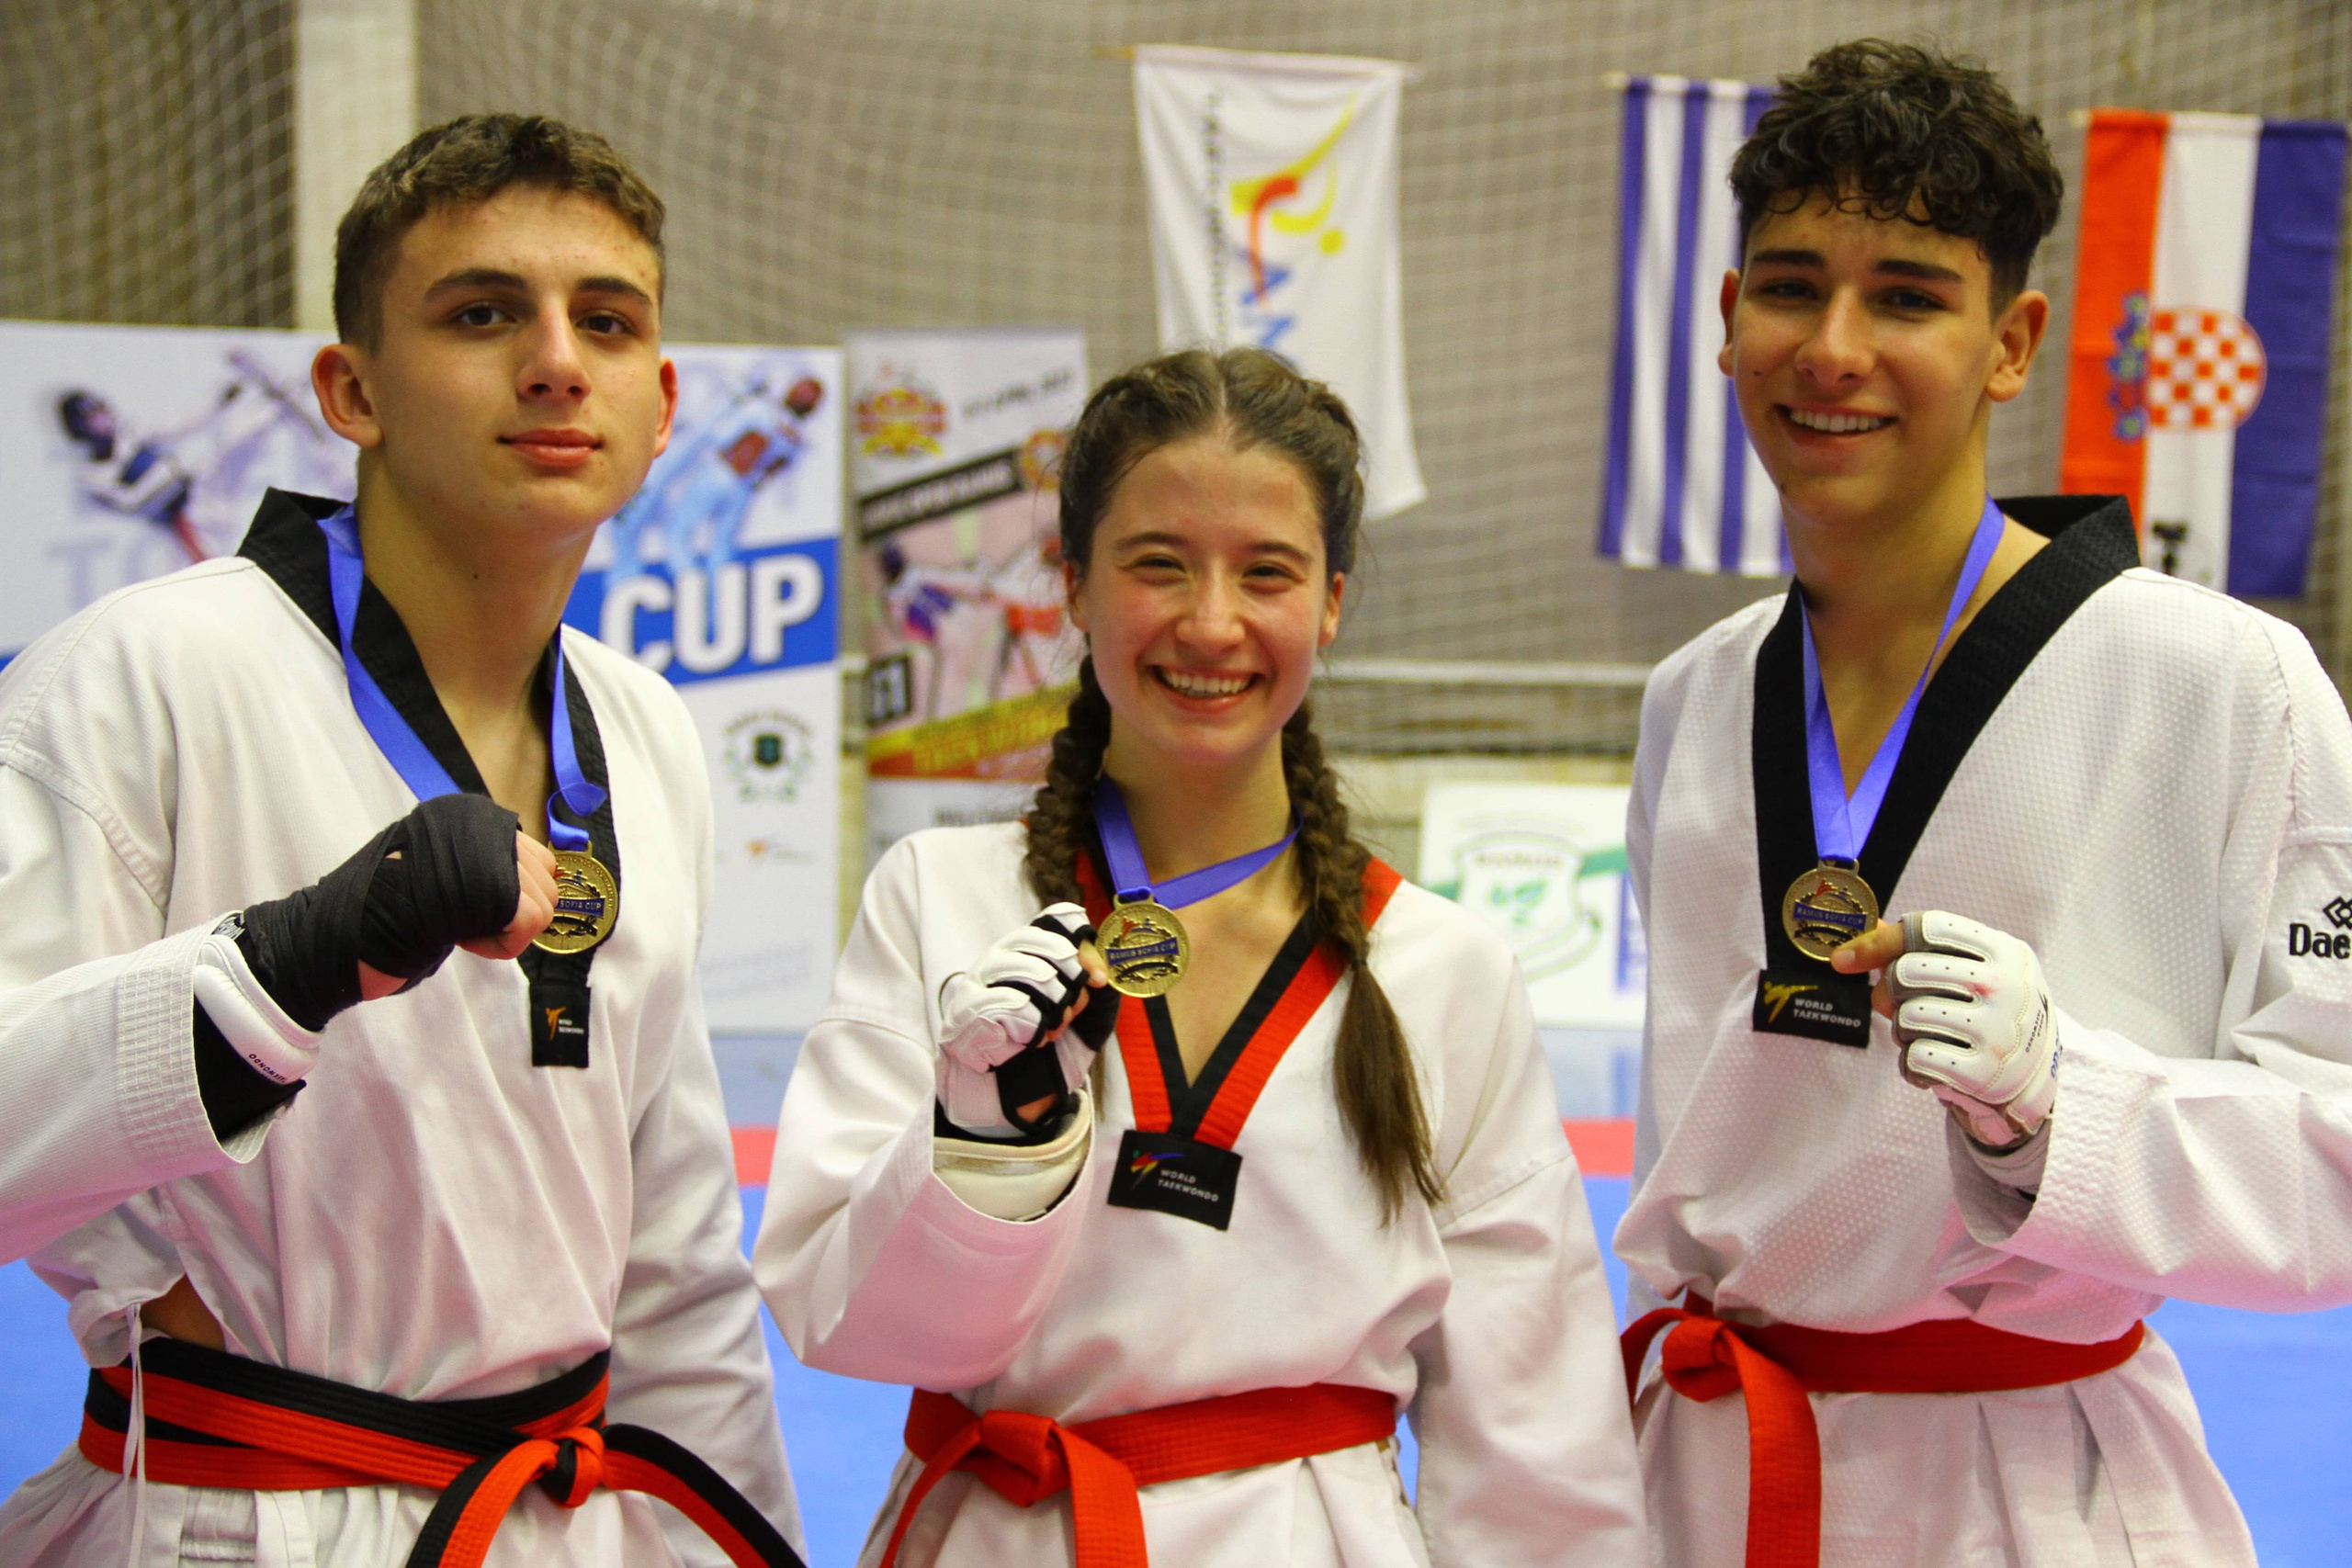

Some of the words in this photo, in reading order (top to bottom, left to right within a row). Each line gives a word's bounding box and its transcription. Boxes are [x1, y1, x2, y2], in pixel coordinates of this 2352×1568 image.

[600, 553, 823, 674] CUP
[560, 900, 583, 909] SOFIA
[585, 902, 602, 910] CUP
[1848, 917, 1863, 925] CUP
[1794, 998, 1834, 1012] WORLD
[1793, 1009, 1862, 1028] TAEKWONDO
[1160, 1169, 1197, 1184] WORLD
[1158, 1179, 1219, 1202] TAEKWONDO
